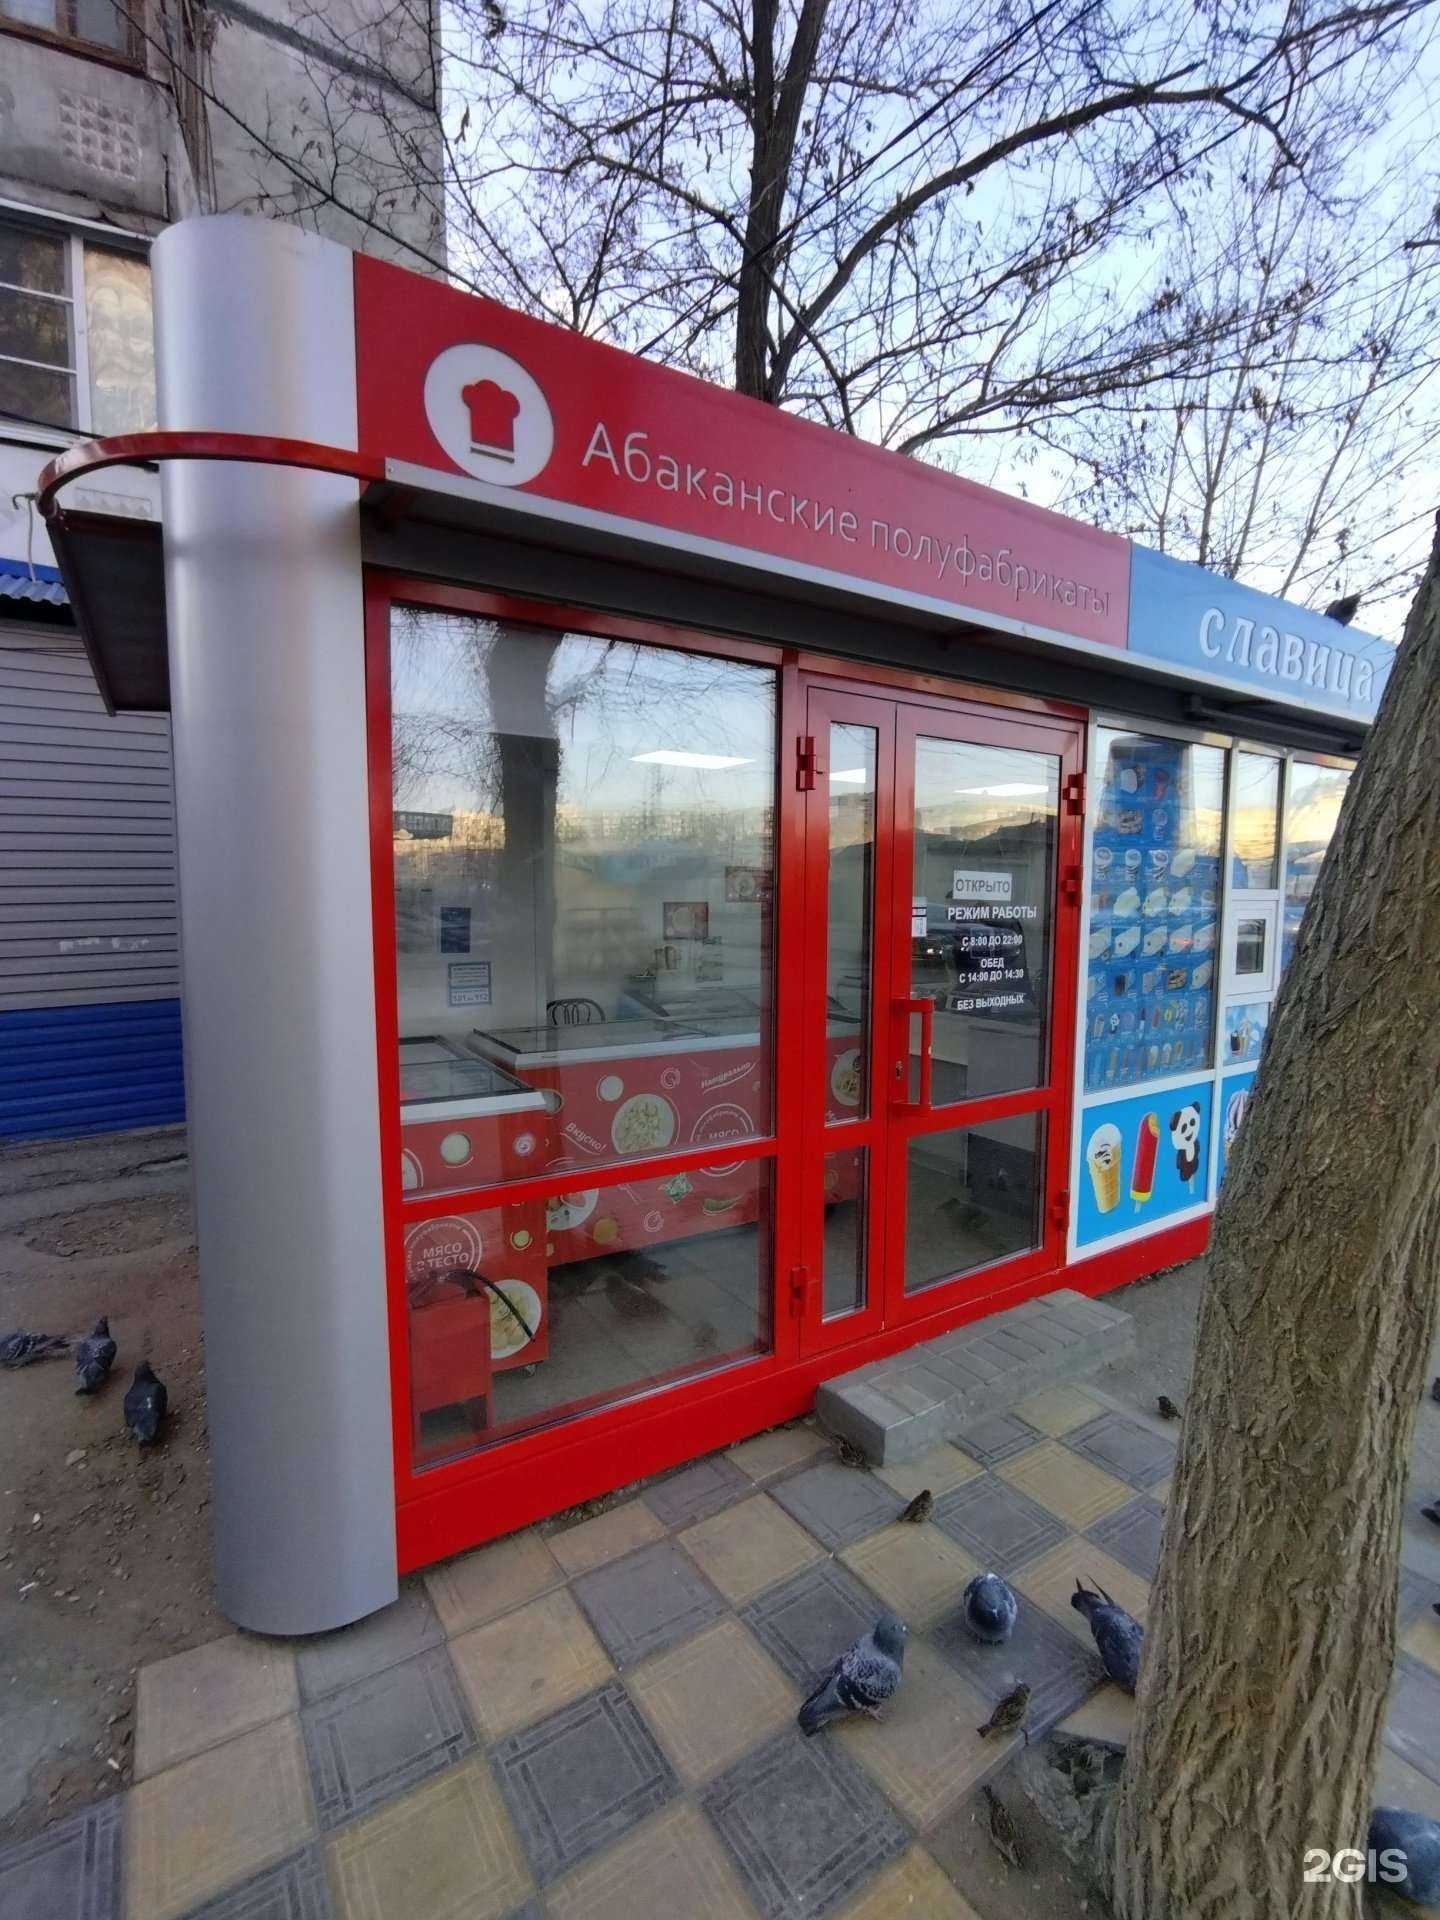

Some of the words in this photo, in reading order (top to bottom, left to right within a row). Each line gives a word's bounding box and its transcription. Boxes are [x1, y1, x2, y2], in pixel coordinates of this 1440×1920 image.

[581, 422, 860, 543] Абаканские
[871, 518, 1111, 618] полуфабрикаты
[955, 878, 1010, 893] ОТКРЫТО
[948, 907, 989, 920] РЕЖИМ
[992, 905, 1037, 919] РАБОТЫ
[962, 936, 969, 947] С
[988, 935, 1001, 947] ДО
[981, 957, 1004, 968] ОБЕД
[959, 973, 966, 983] С
[990, 970, 1002, 982] ДО
[957, 999, 974, 1010] БЕЗ
[976, 994, 1024, 1009] ВЫХОДНЫХ
[423, 1242, 462, 1259] МЯСО
